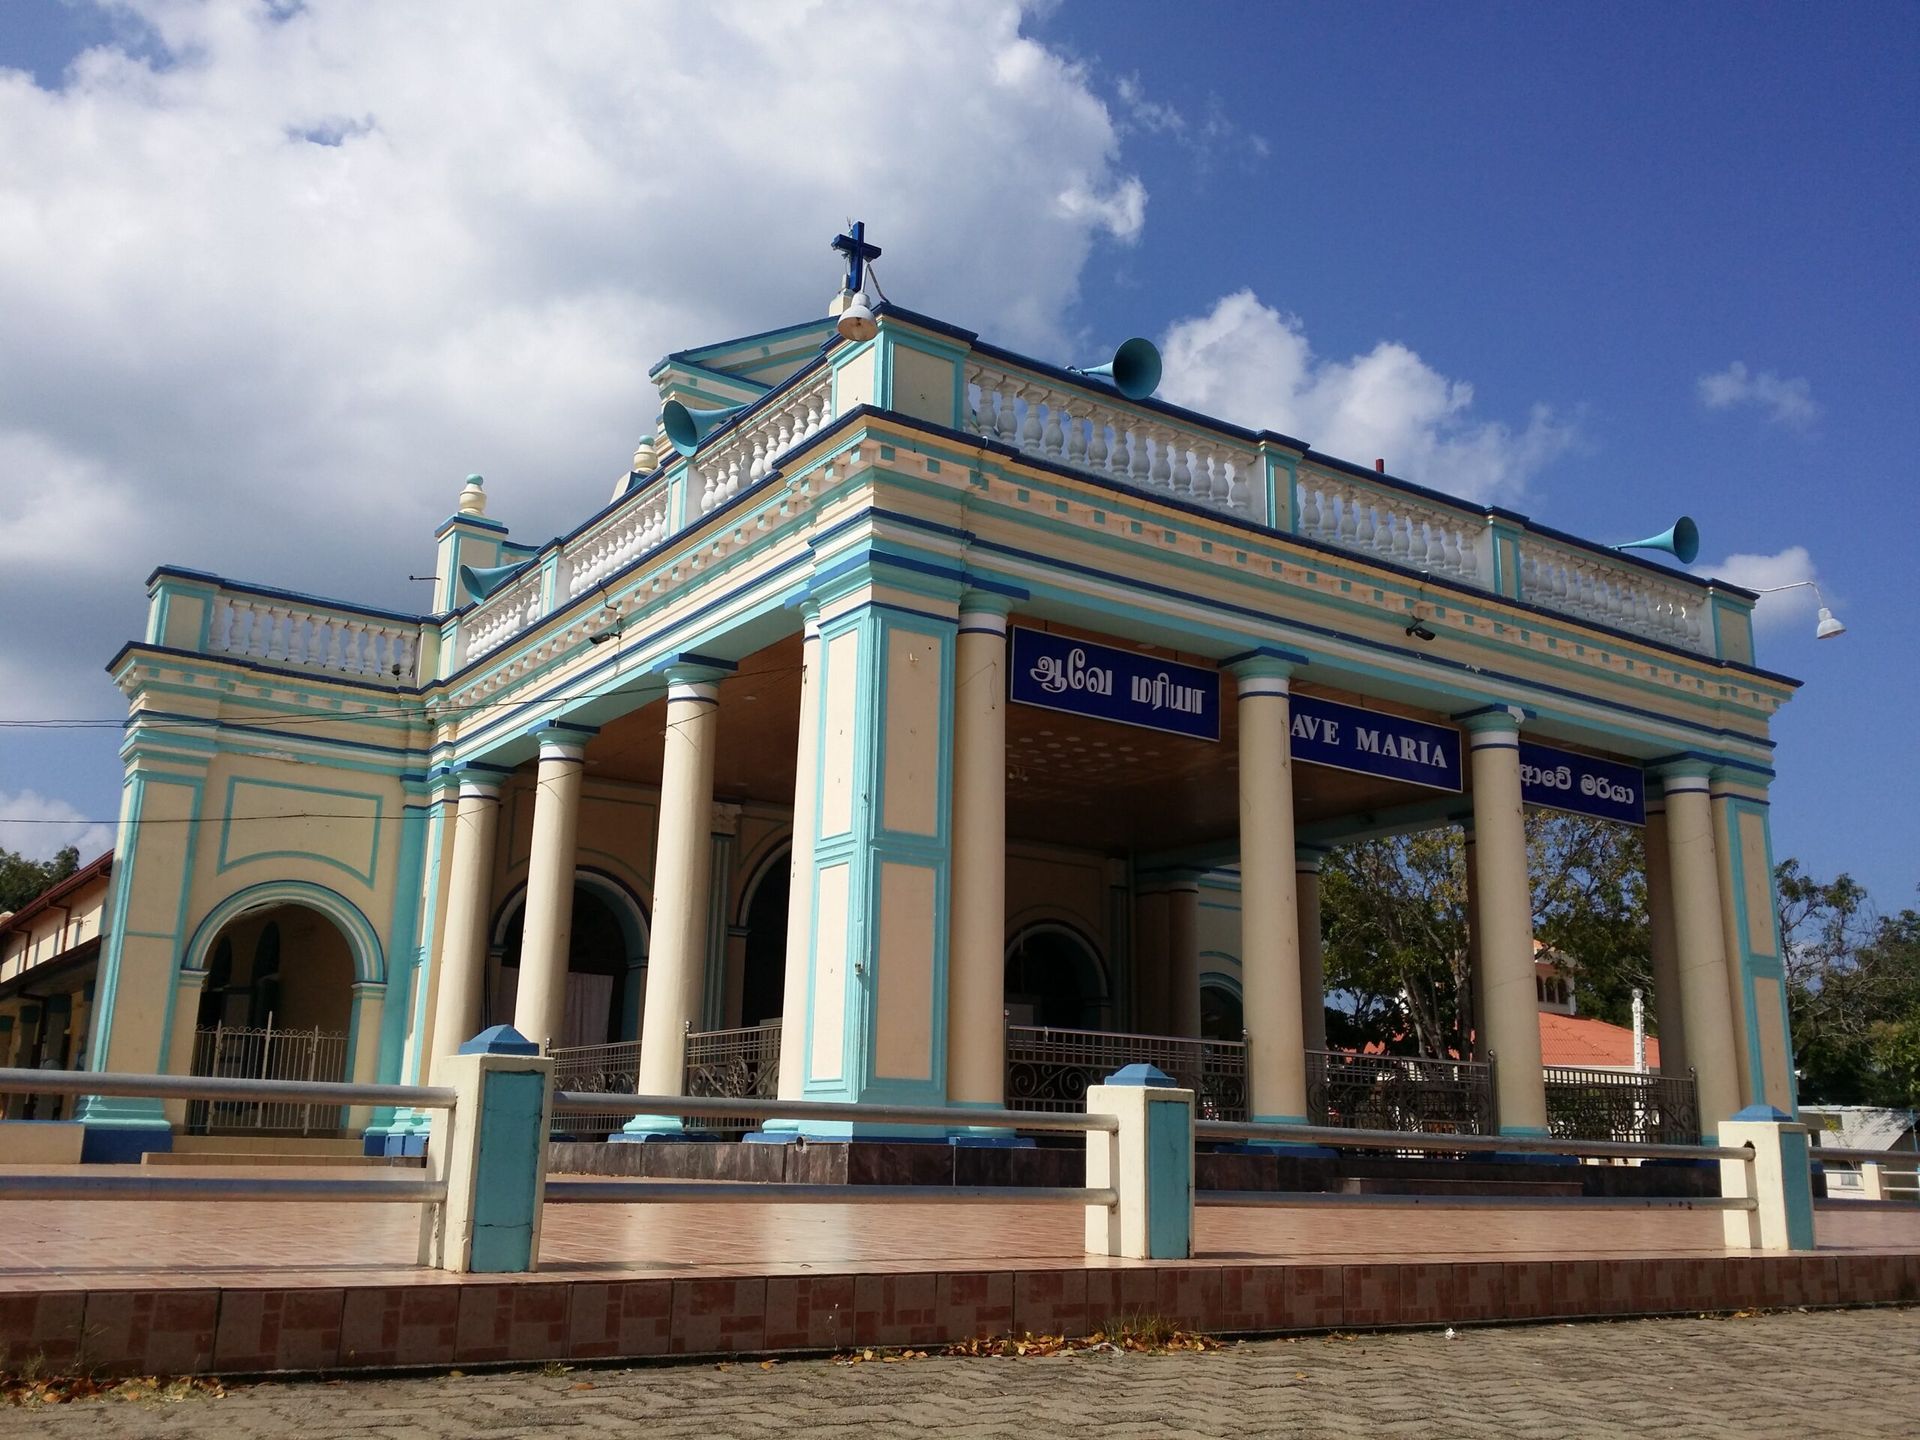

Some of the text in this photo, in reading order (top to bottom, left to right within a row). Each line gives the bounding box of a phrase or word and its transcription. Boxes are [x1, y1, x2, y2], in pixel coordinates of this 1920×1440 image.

[1030, 648, 1206, 714] ஆவே மரியா
[1291, 713, 1448, 769] AVE MARIA
[1581, 774, 1635, 805] මරියා
